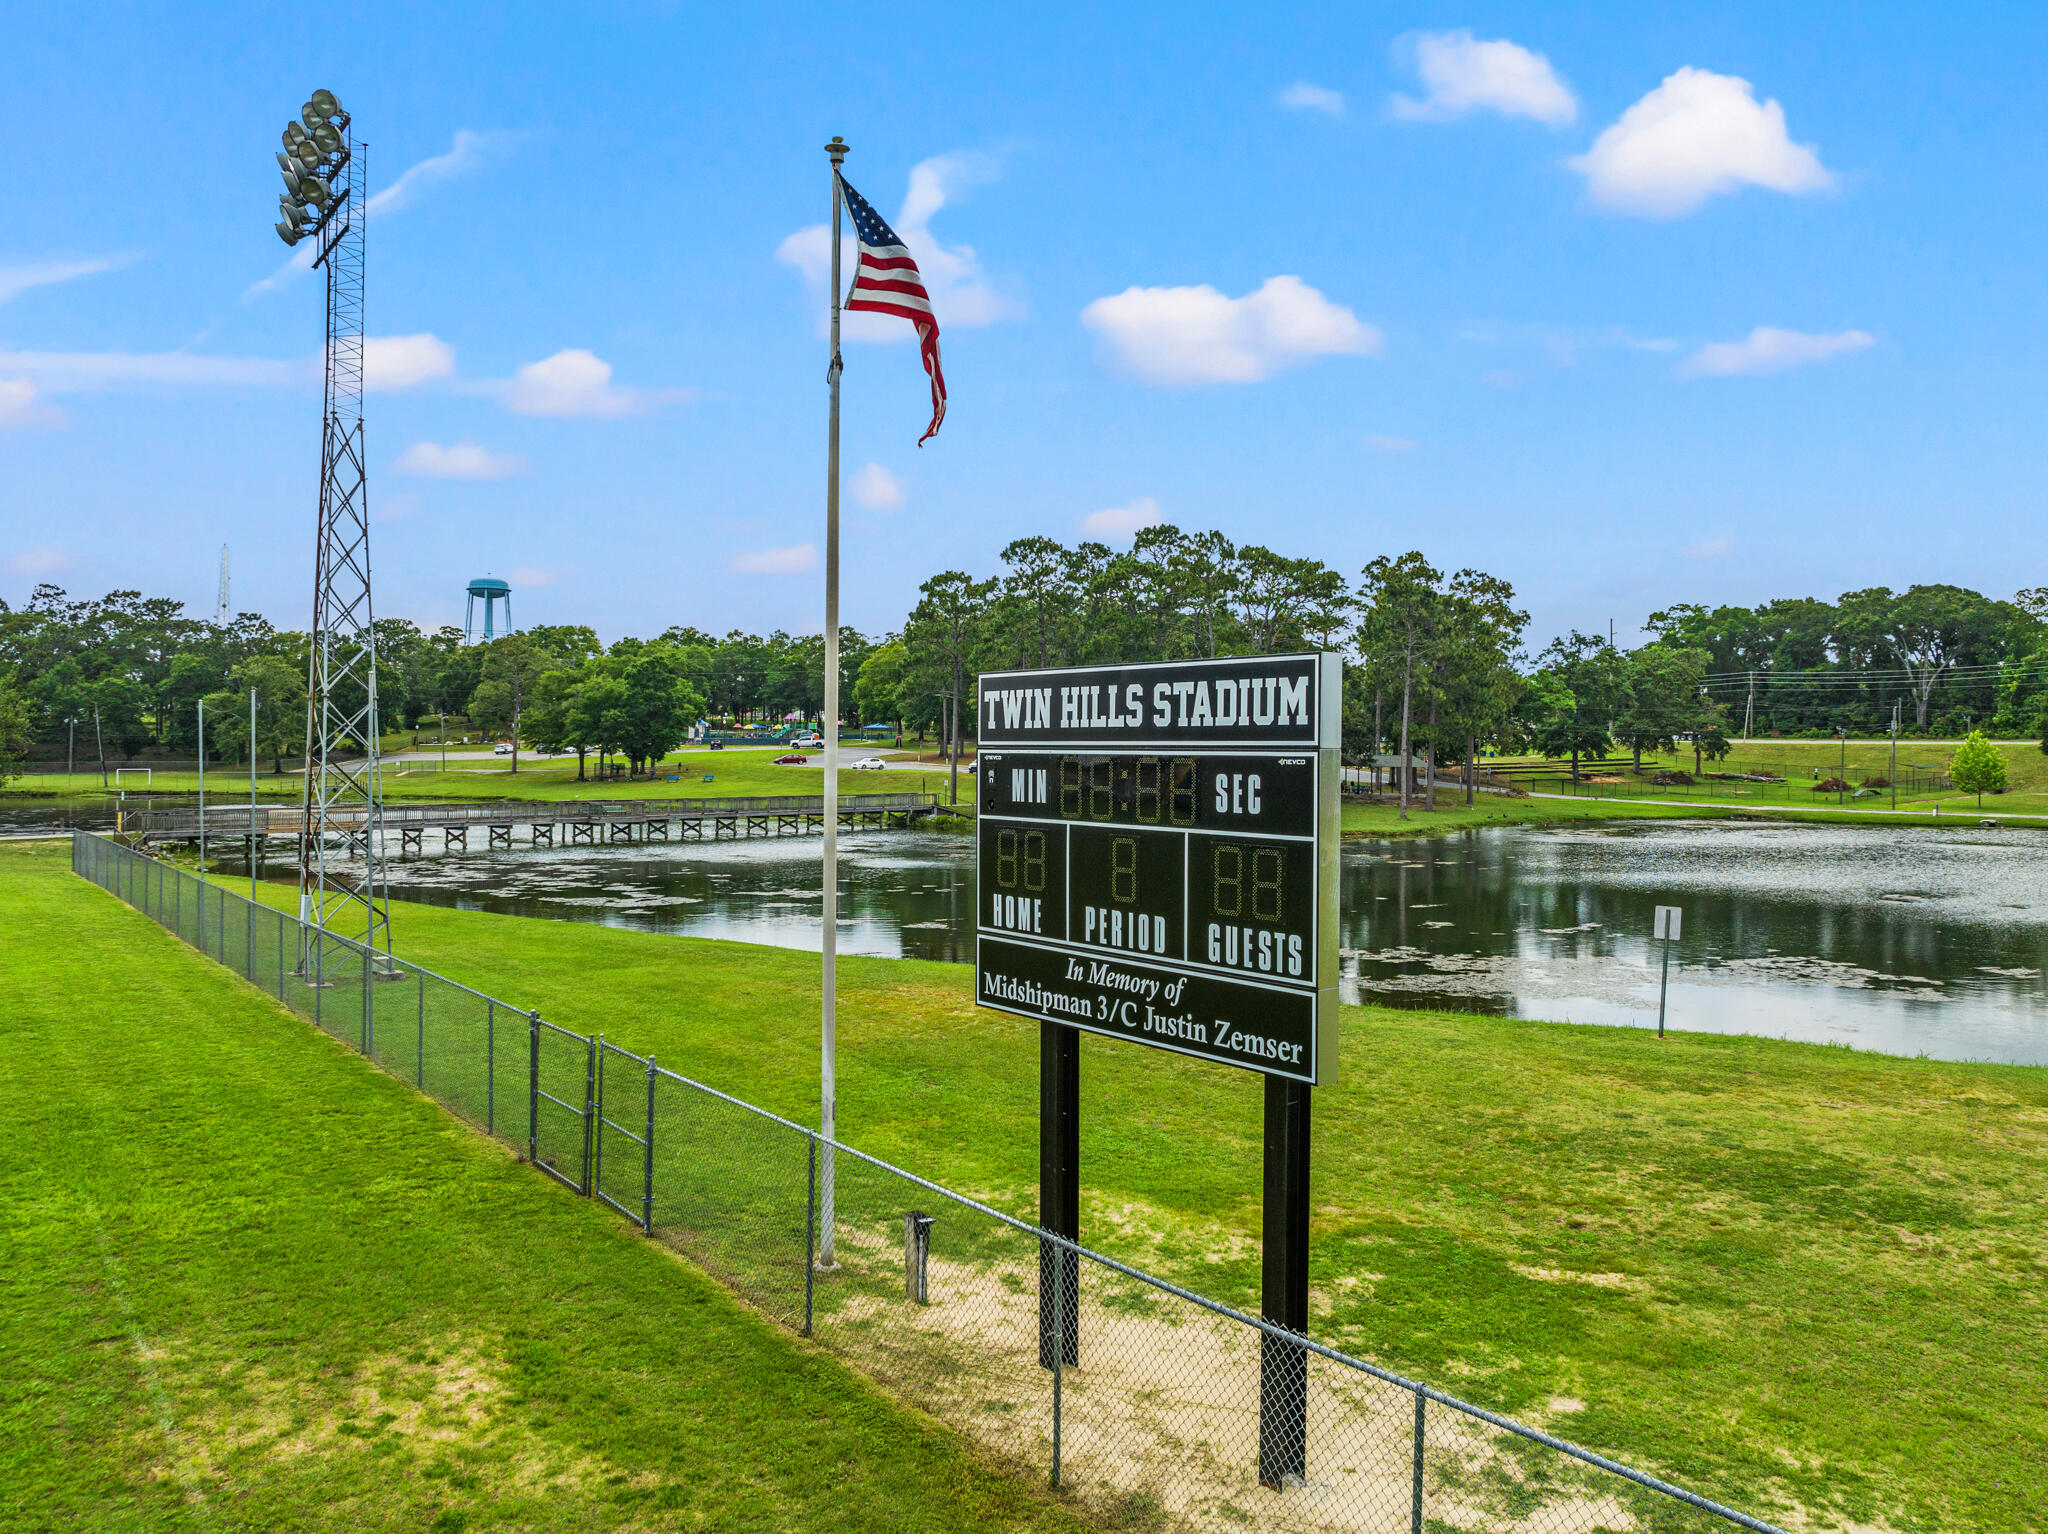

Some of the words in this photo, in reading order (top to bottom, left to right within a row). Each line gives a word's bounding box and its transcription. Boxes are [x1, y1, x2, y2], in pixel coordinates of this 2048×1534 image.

[984, 688, 1052, 730] TWIN
[1060, 683, 1144, 728] HILLS
[1153, 676, 1309, 728] STADIUM
[1011, 768, 1047, 804] MIN
[1215, 773, 1261, 815] SEC
[993, 893, 1042, 934] HOME
[1085, 905, 1166, 954] PERIOD
[1208, 923, 1302, 976] GUESTS
[1065, 957, 1084, 982] In
[1087, 961, 1160, 1001] Memory
[1164, 978, 1187, 1006] of
[984, 972, 1092, 1018] Midshipman
[1097, 995, 1138, 1028] 3/C
[1143, 1005, 1208, 1044] Justin
[1213, 1020, 1303, 1065] Zemser
